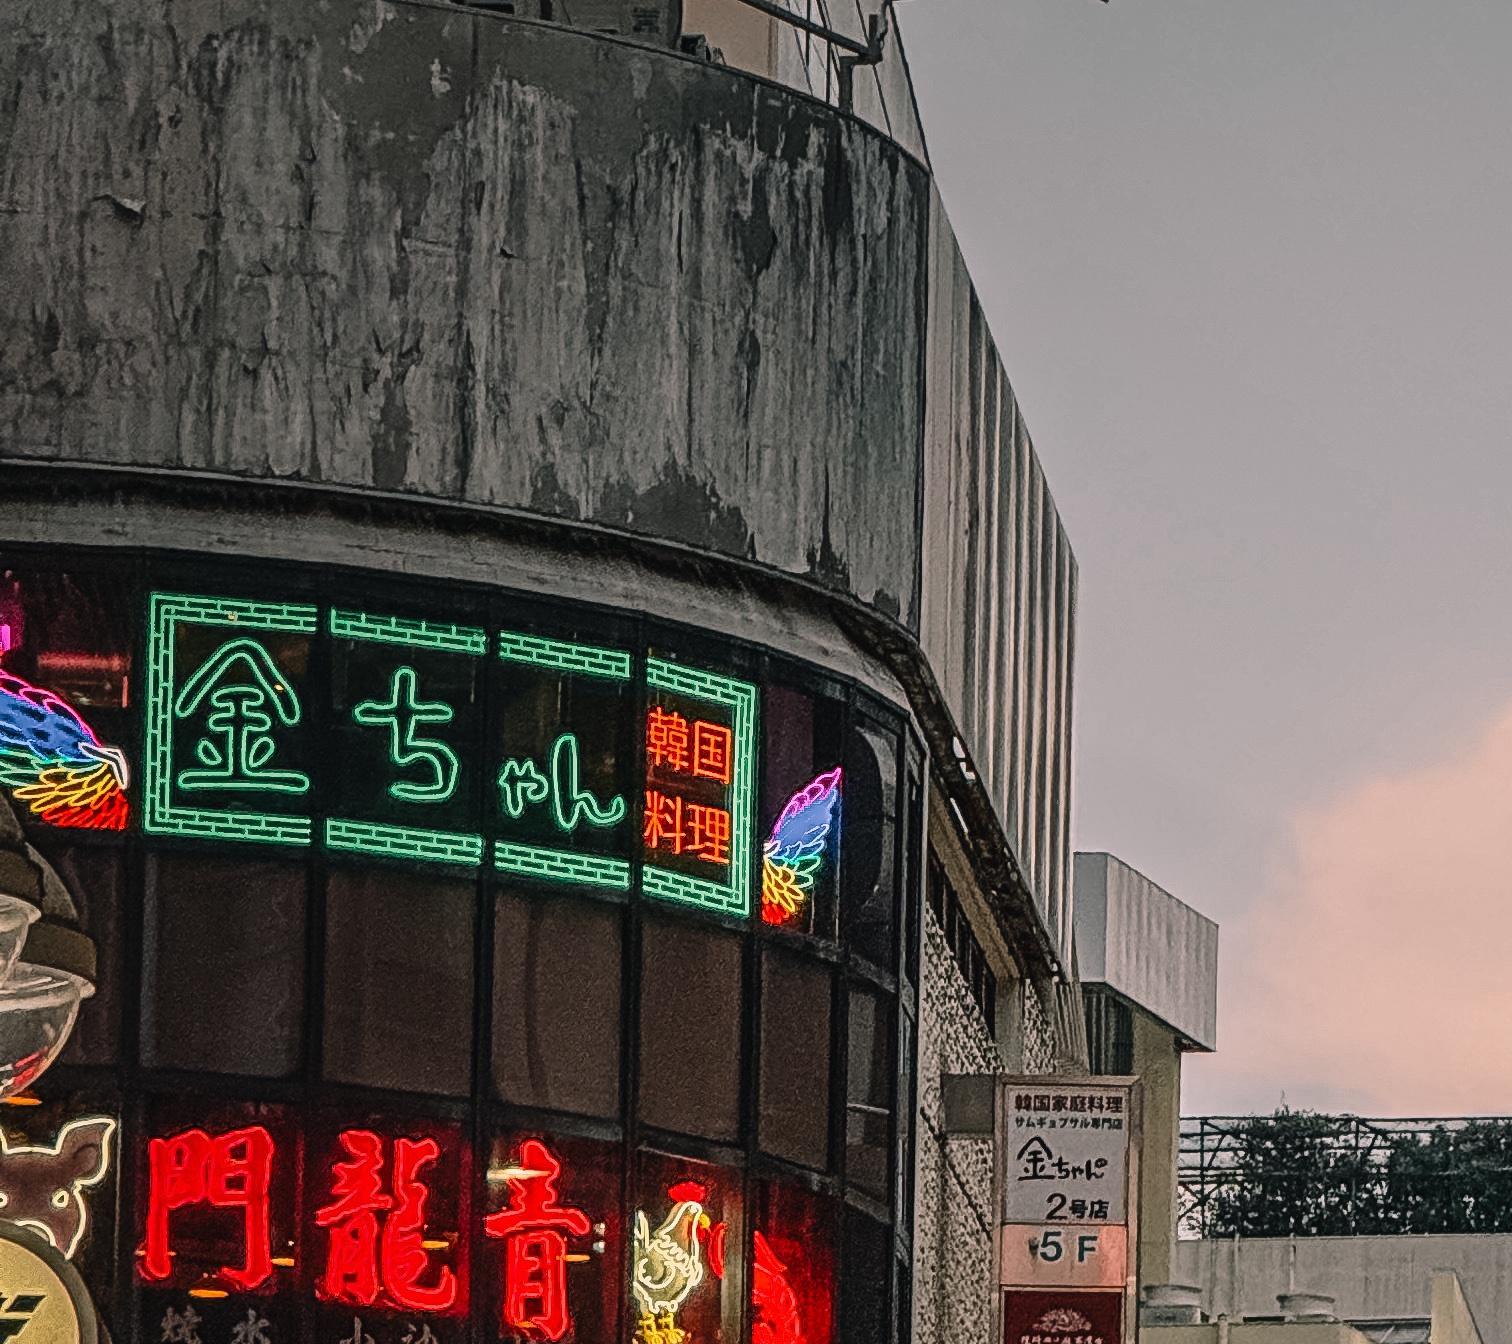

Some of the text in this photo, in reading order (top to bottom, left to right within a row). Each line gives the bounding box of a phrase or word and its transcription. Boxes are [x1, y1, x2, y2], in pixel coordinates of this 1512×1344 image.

[177, 638, 626, 830] 金ちゃん
[647, 706, 733, 785] 韓国
[644, 789, 733, 866] 料理
[1014, 1094, 1124, 1114] 韓国家庭料理
[1045, 1192, 1110, 1221] 2号店
